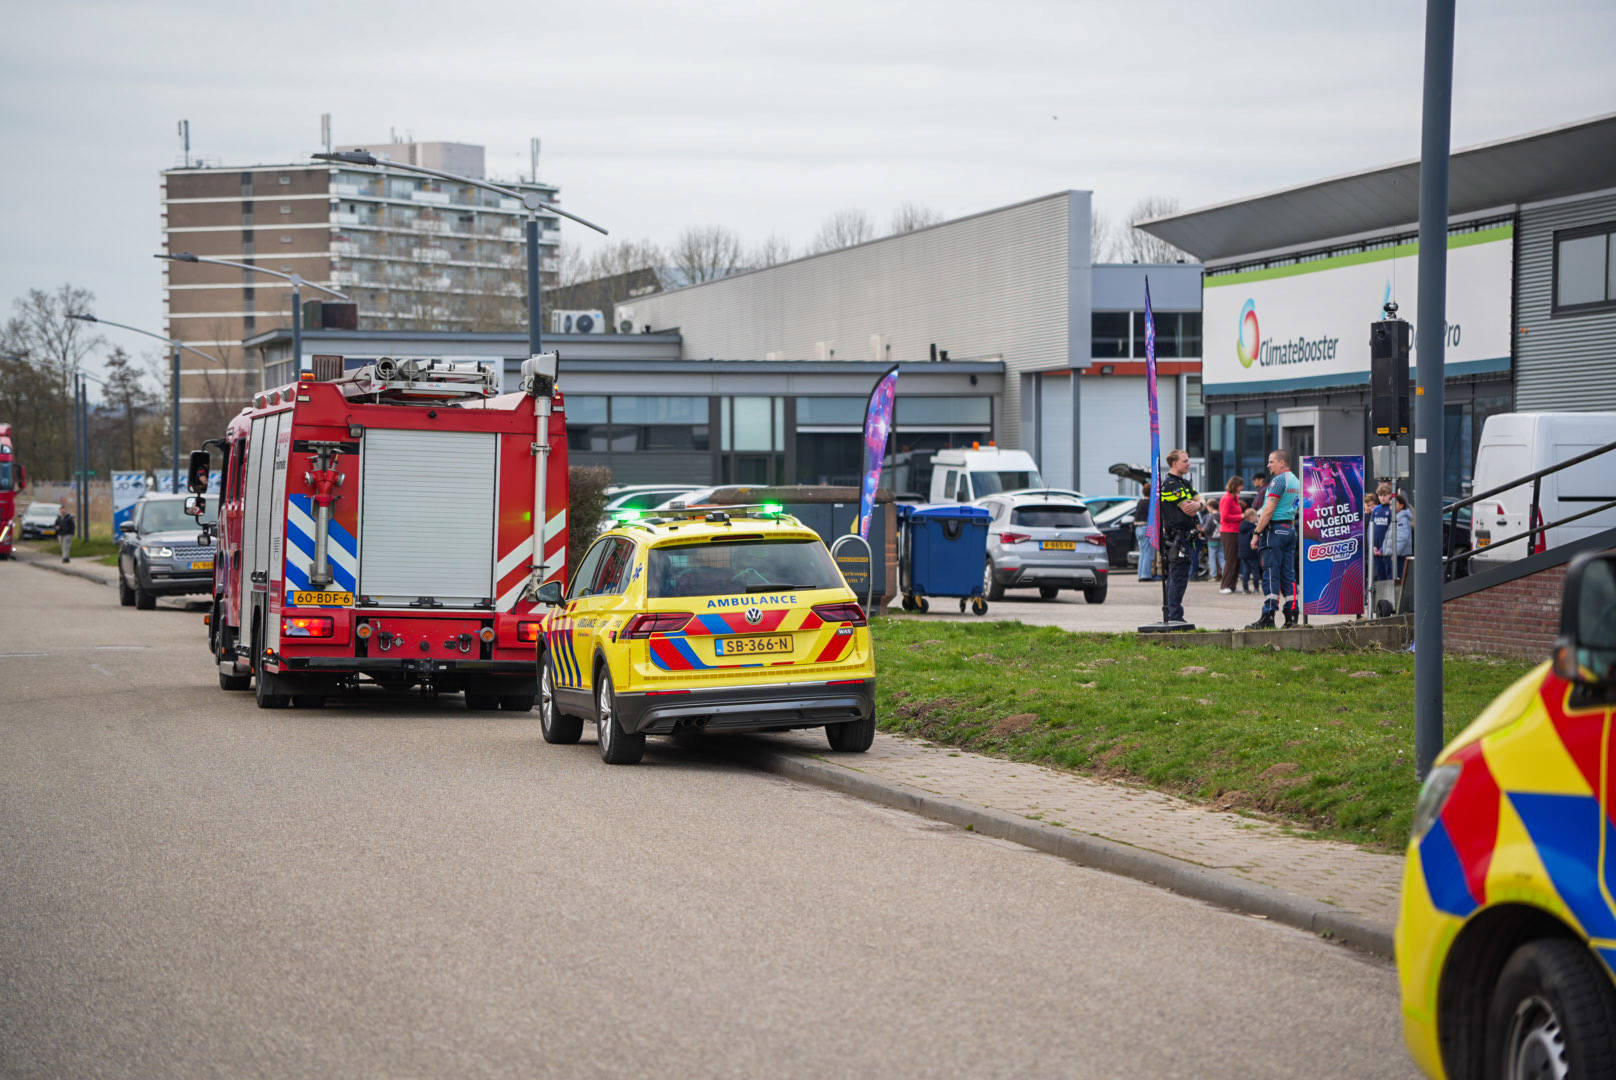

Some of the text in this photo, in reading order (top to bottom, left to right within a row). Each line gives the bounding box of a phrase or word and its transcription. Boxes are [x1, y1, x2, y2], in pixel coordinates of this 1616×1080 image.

[1260, 335, 1339, 366] ClimateBooster
[1314, 503, 1350, 517] TOT DE
[1306, 512, 1360, 529] VOLGENDE
[1320, 525, 1350, 538] KEER!
[1310, 541, 1355, 559] BOUNCE
[297, 593, 350, 604] 60-BDF-6
[707, 595, 798, 609] AMBULANCE
[726, 637, 788, 653] SB-366-N
